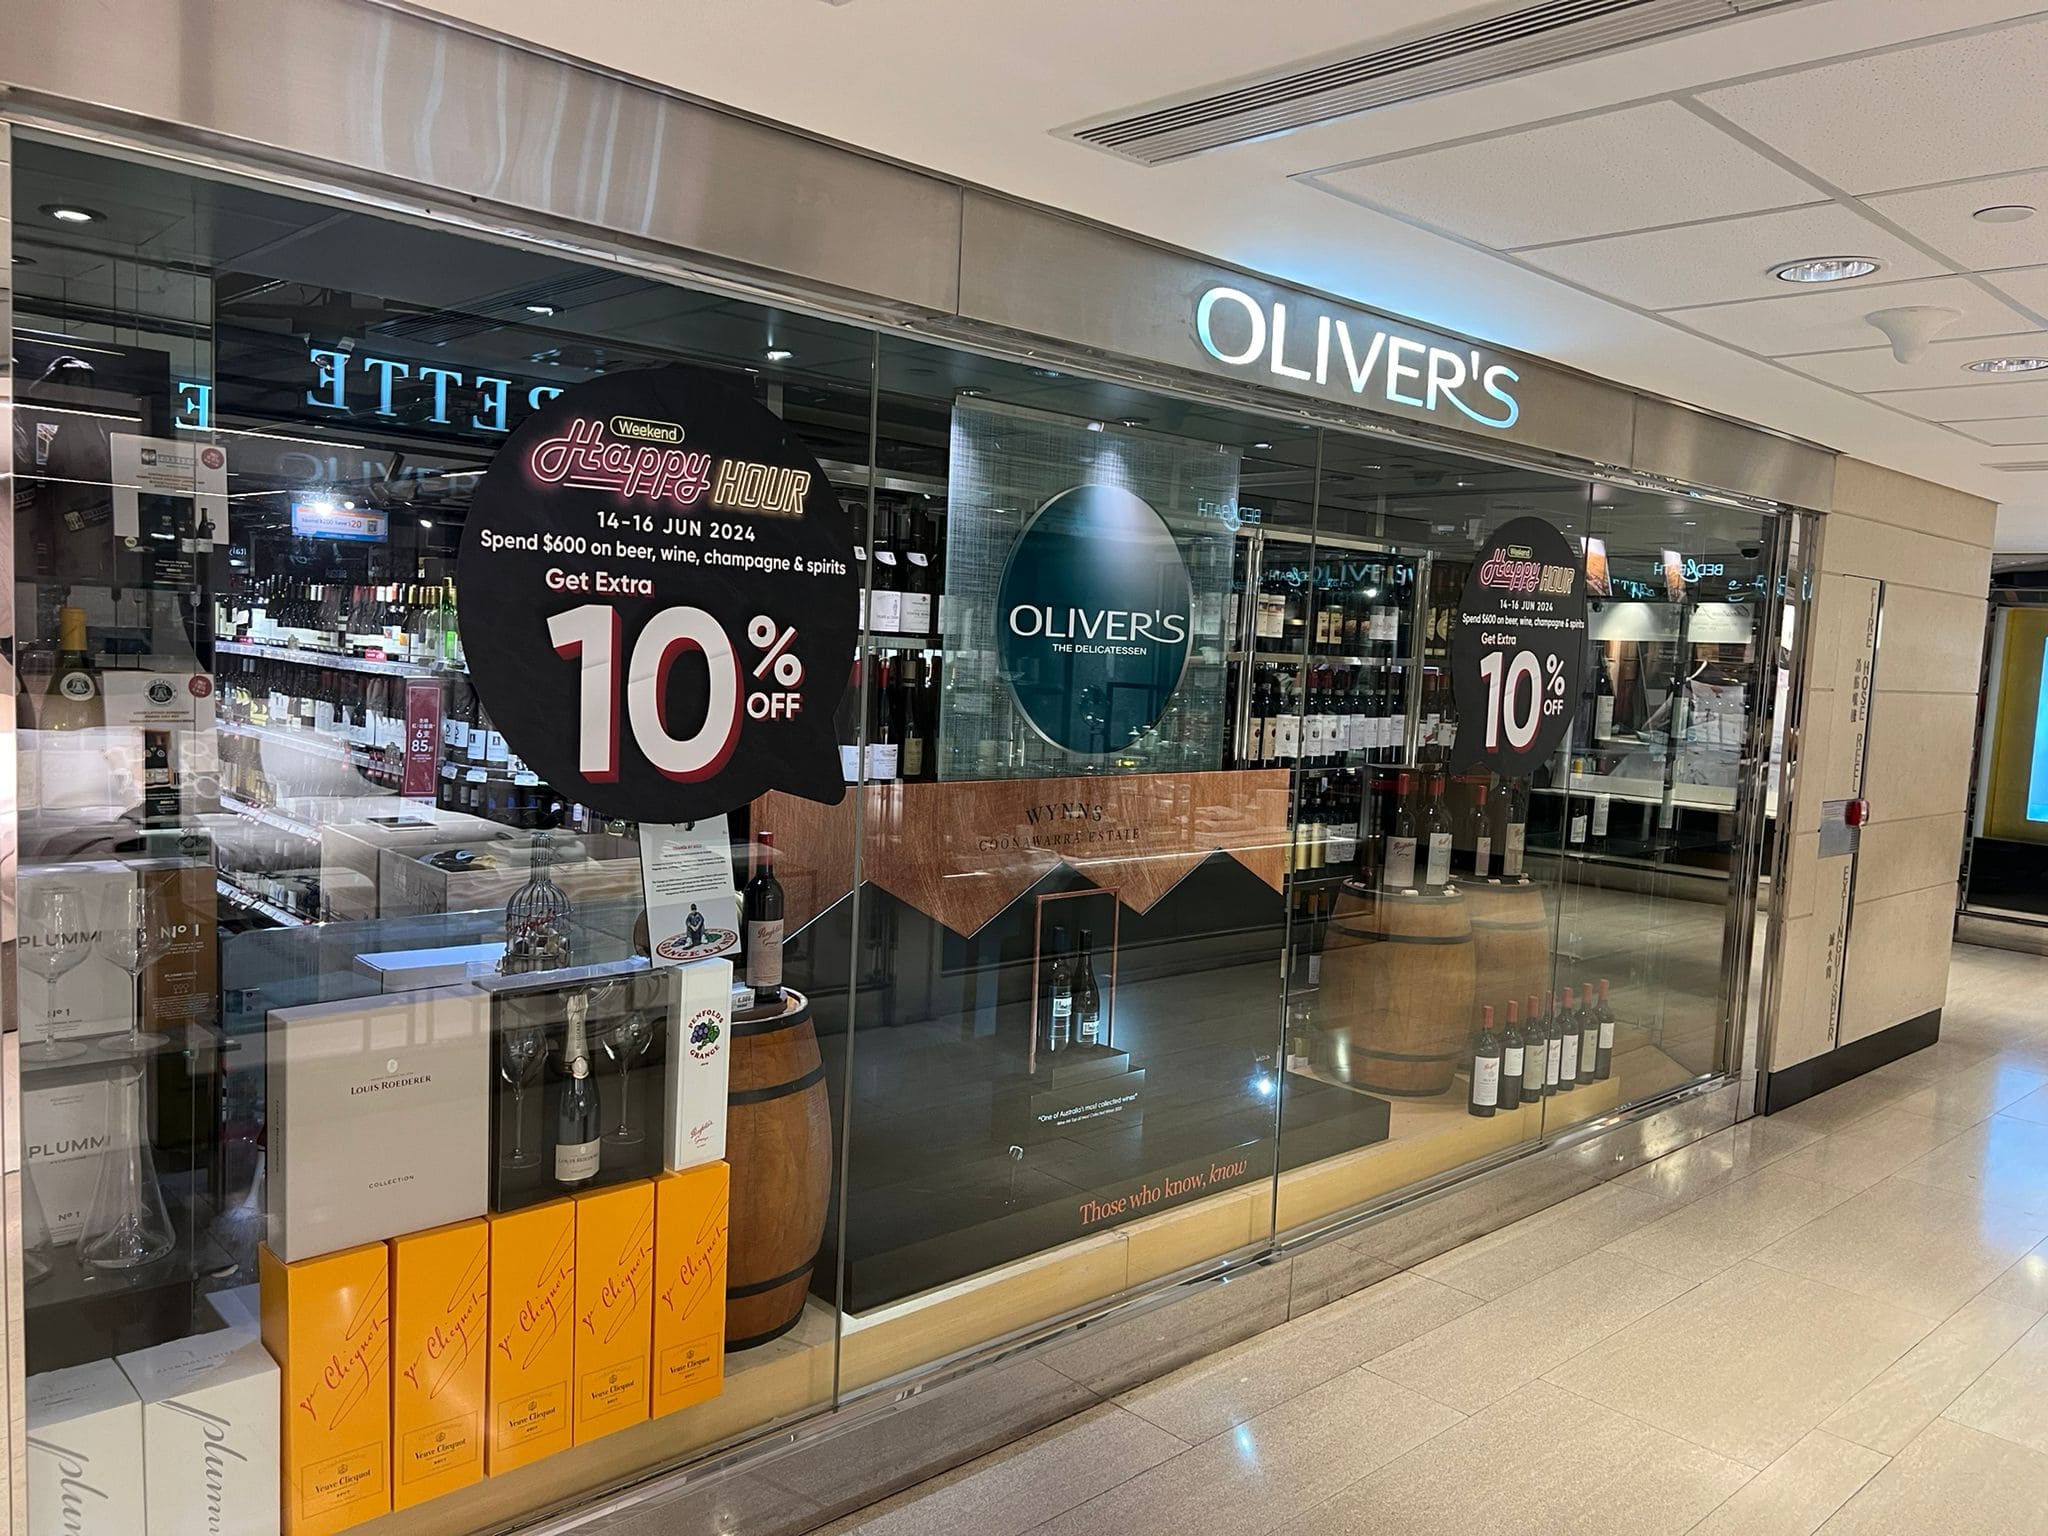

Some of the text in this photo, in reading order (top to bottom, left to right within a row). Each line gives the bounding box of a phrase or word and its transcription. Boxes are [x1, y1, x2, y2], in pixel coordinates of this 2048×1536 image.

[1197, 287, 1519, 429] OLIVER'S
[618, 419, 678, 441] Weekend
[531, 418, 811, 514] Happy HOUR
[597, 511, 755, 542] 14-16 JUN 2024
[480, 529, 846, 577] Spend $600 on beer, wine, champagne & spirits
[545, 568, 654, 596] Get Extra
[1481, 548, 1540, 592] Happy
[1540, 565, 1575, 594] HOUR
[1500, 599, 1553, 611] 14-16 JUN 2024
[1009, 604, 1185, 644] OLIVER'S
[1462, 613, 1480, 625] Spend
[1482, 614, 1496, 624] $600
[1505, 616, 1519, 626] beer,
[1520, 616, 1533, 627] wine,
[1534, 617, 1564, 629] champagne
[1570, 619, 1585, 630] spirits
[1052, 643, 1147, 655] THE DELICATESSEN
[1481, 632, 1516, 645] Get Extra
[546, 604, 803, 784] 10 %
[1480, 651, 1565, 751] 10 %
[1852, 587, 1877, 793] FIRE HOSE REEL
[746, 692, 801, 721] OFF
[1544, 699, 1564, 715] OFF
[1025, 803, 1103, 826] WYNNS
[978, 828, 1140, 851] COONAWARRA ESTATE
[1827, 866, 1849, 1041] EXTINGUISHER
[688, 1009, 724, 1029] PENFOLDS
[690, 1044, 720, 1059] GRANGE
[350, 1084, 380, 1096] LOUIS
[381, 1075, 432, 1090] ROEDERER
[368, 1175, 415, 1189] COLLECTION
[1080, 1158, 1248, 1226] Those who know, know
